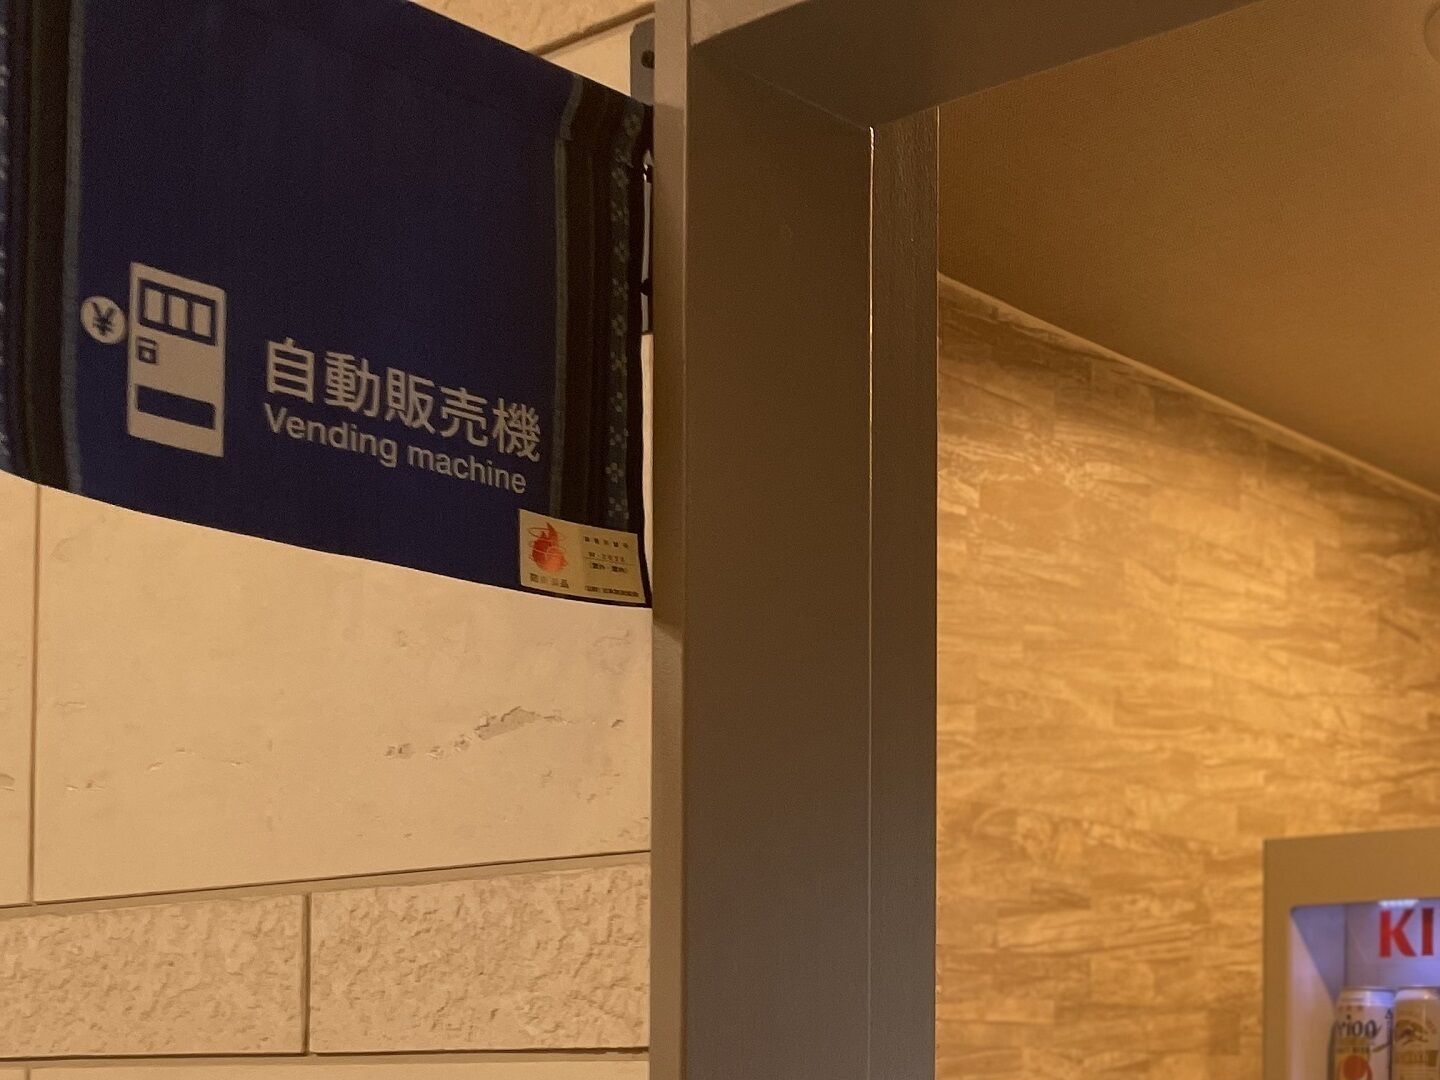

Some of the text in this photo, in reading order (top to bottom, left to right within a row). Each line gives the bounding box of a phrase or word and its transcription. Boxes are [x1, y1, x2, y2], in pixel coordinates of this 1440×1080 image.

[264, 403, 526, 493] Vending machine
[266, 337, 540, 461] 自動販売機
